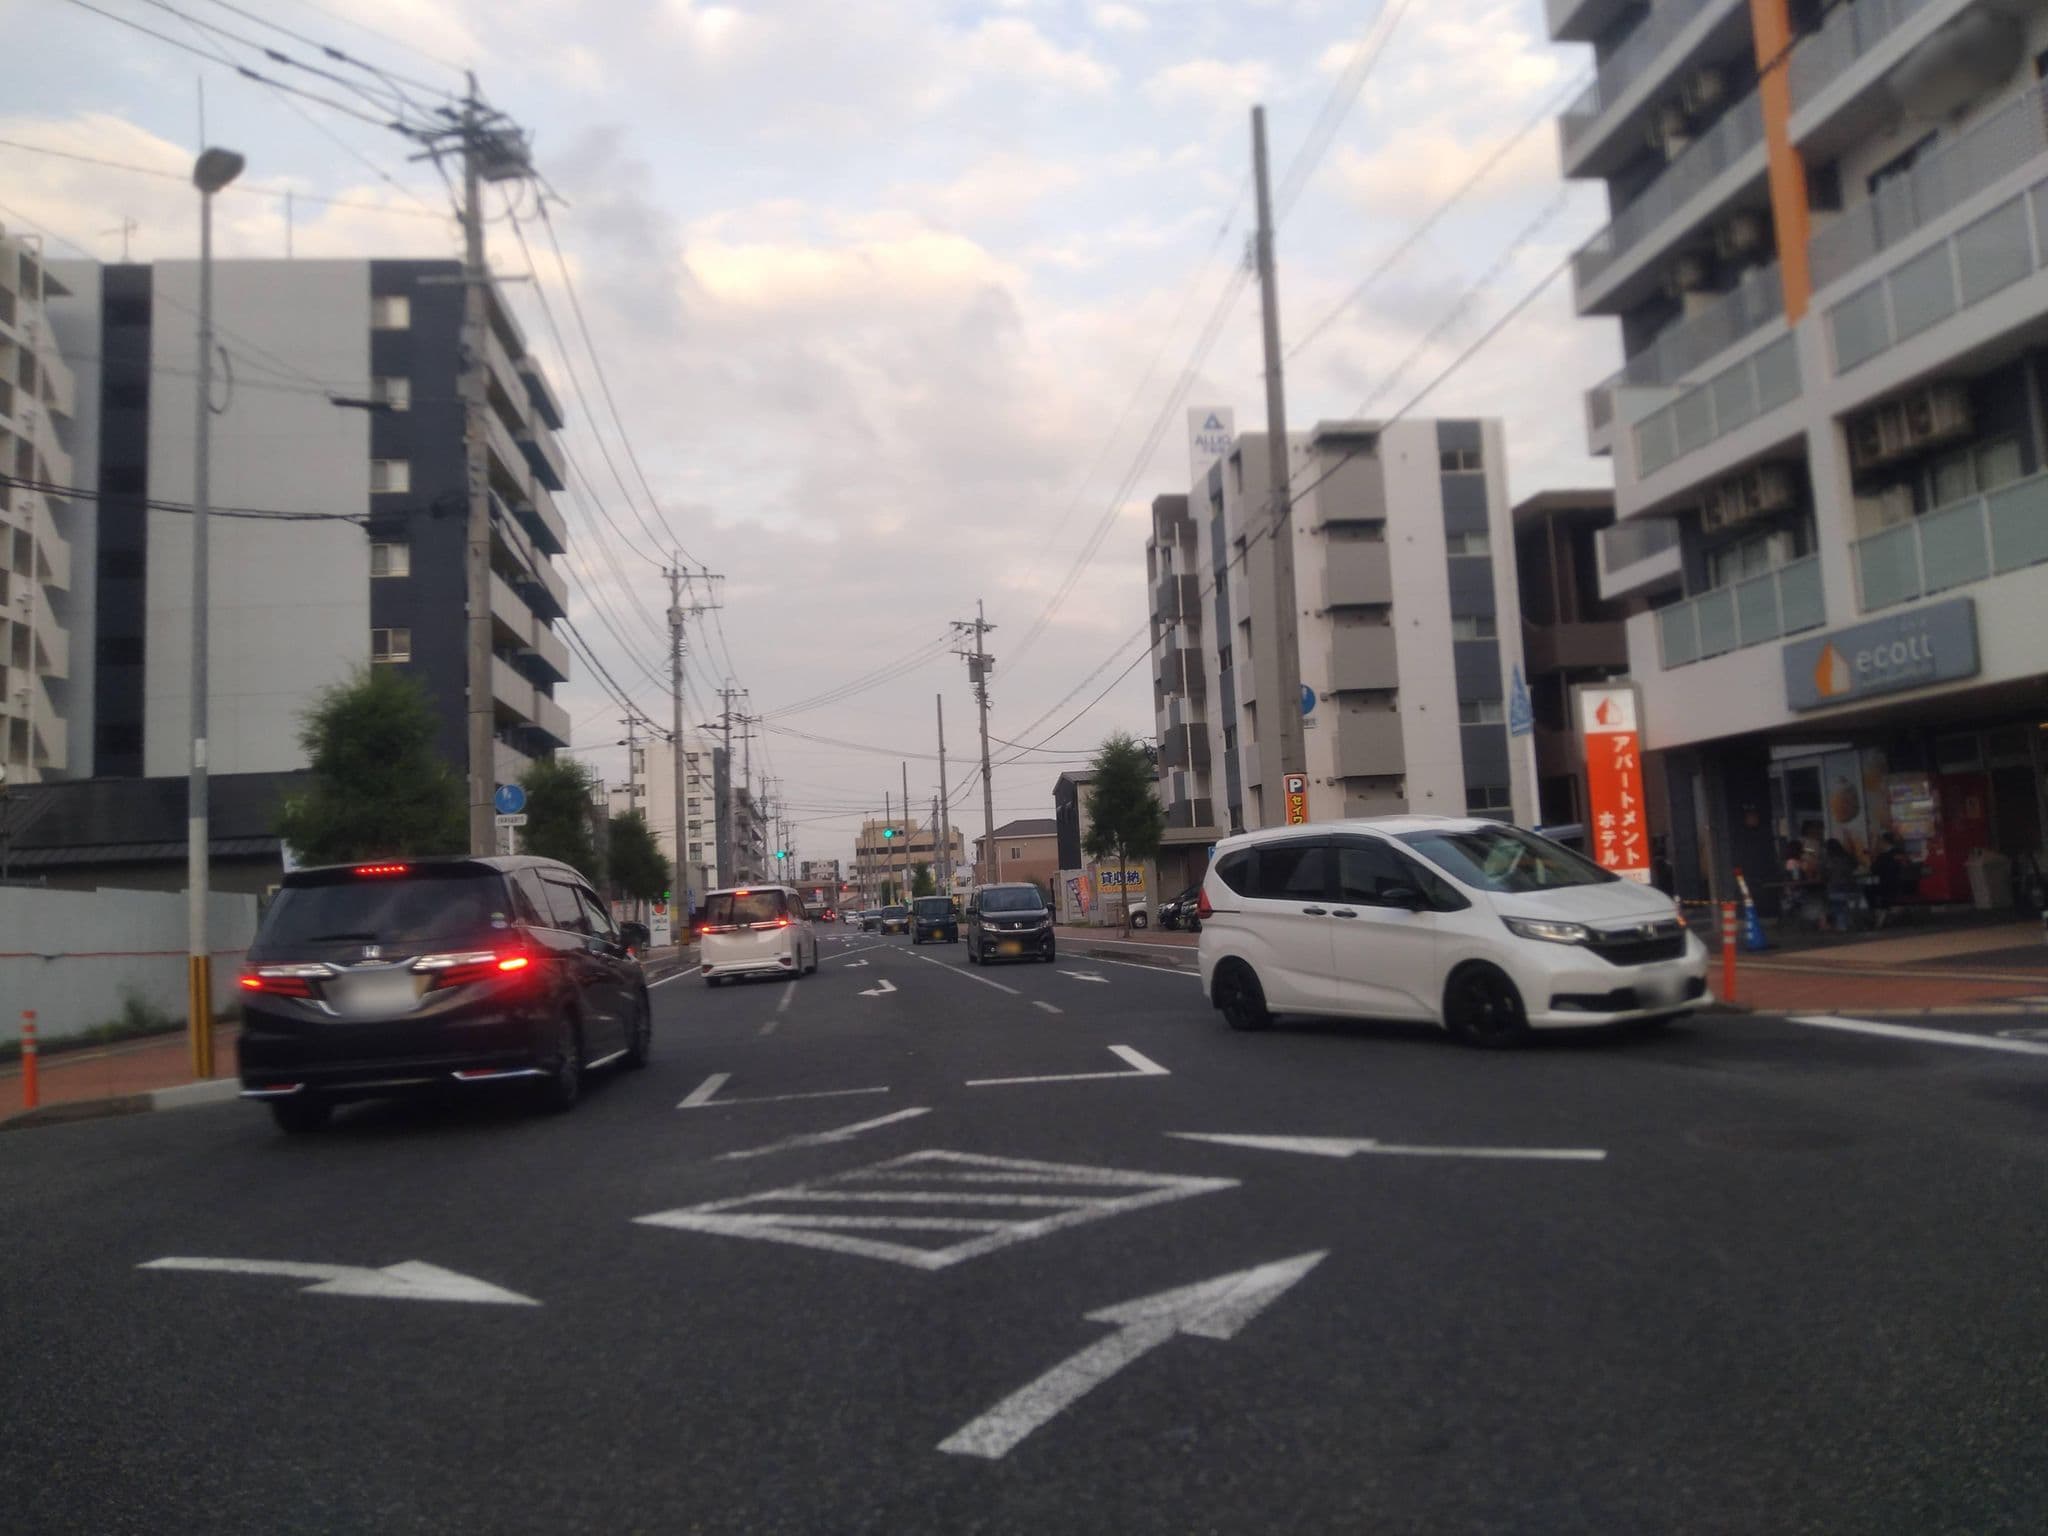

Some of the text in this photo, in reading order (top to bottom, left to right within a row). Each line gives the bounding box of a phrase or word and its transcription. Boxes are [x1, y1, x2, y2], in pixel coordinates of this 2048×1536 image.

[1289, 778, 1302, 793] P
[1598, 811, 1620, 867] ホテル
